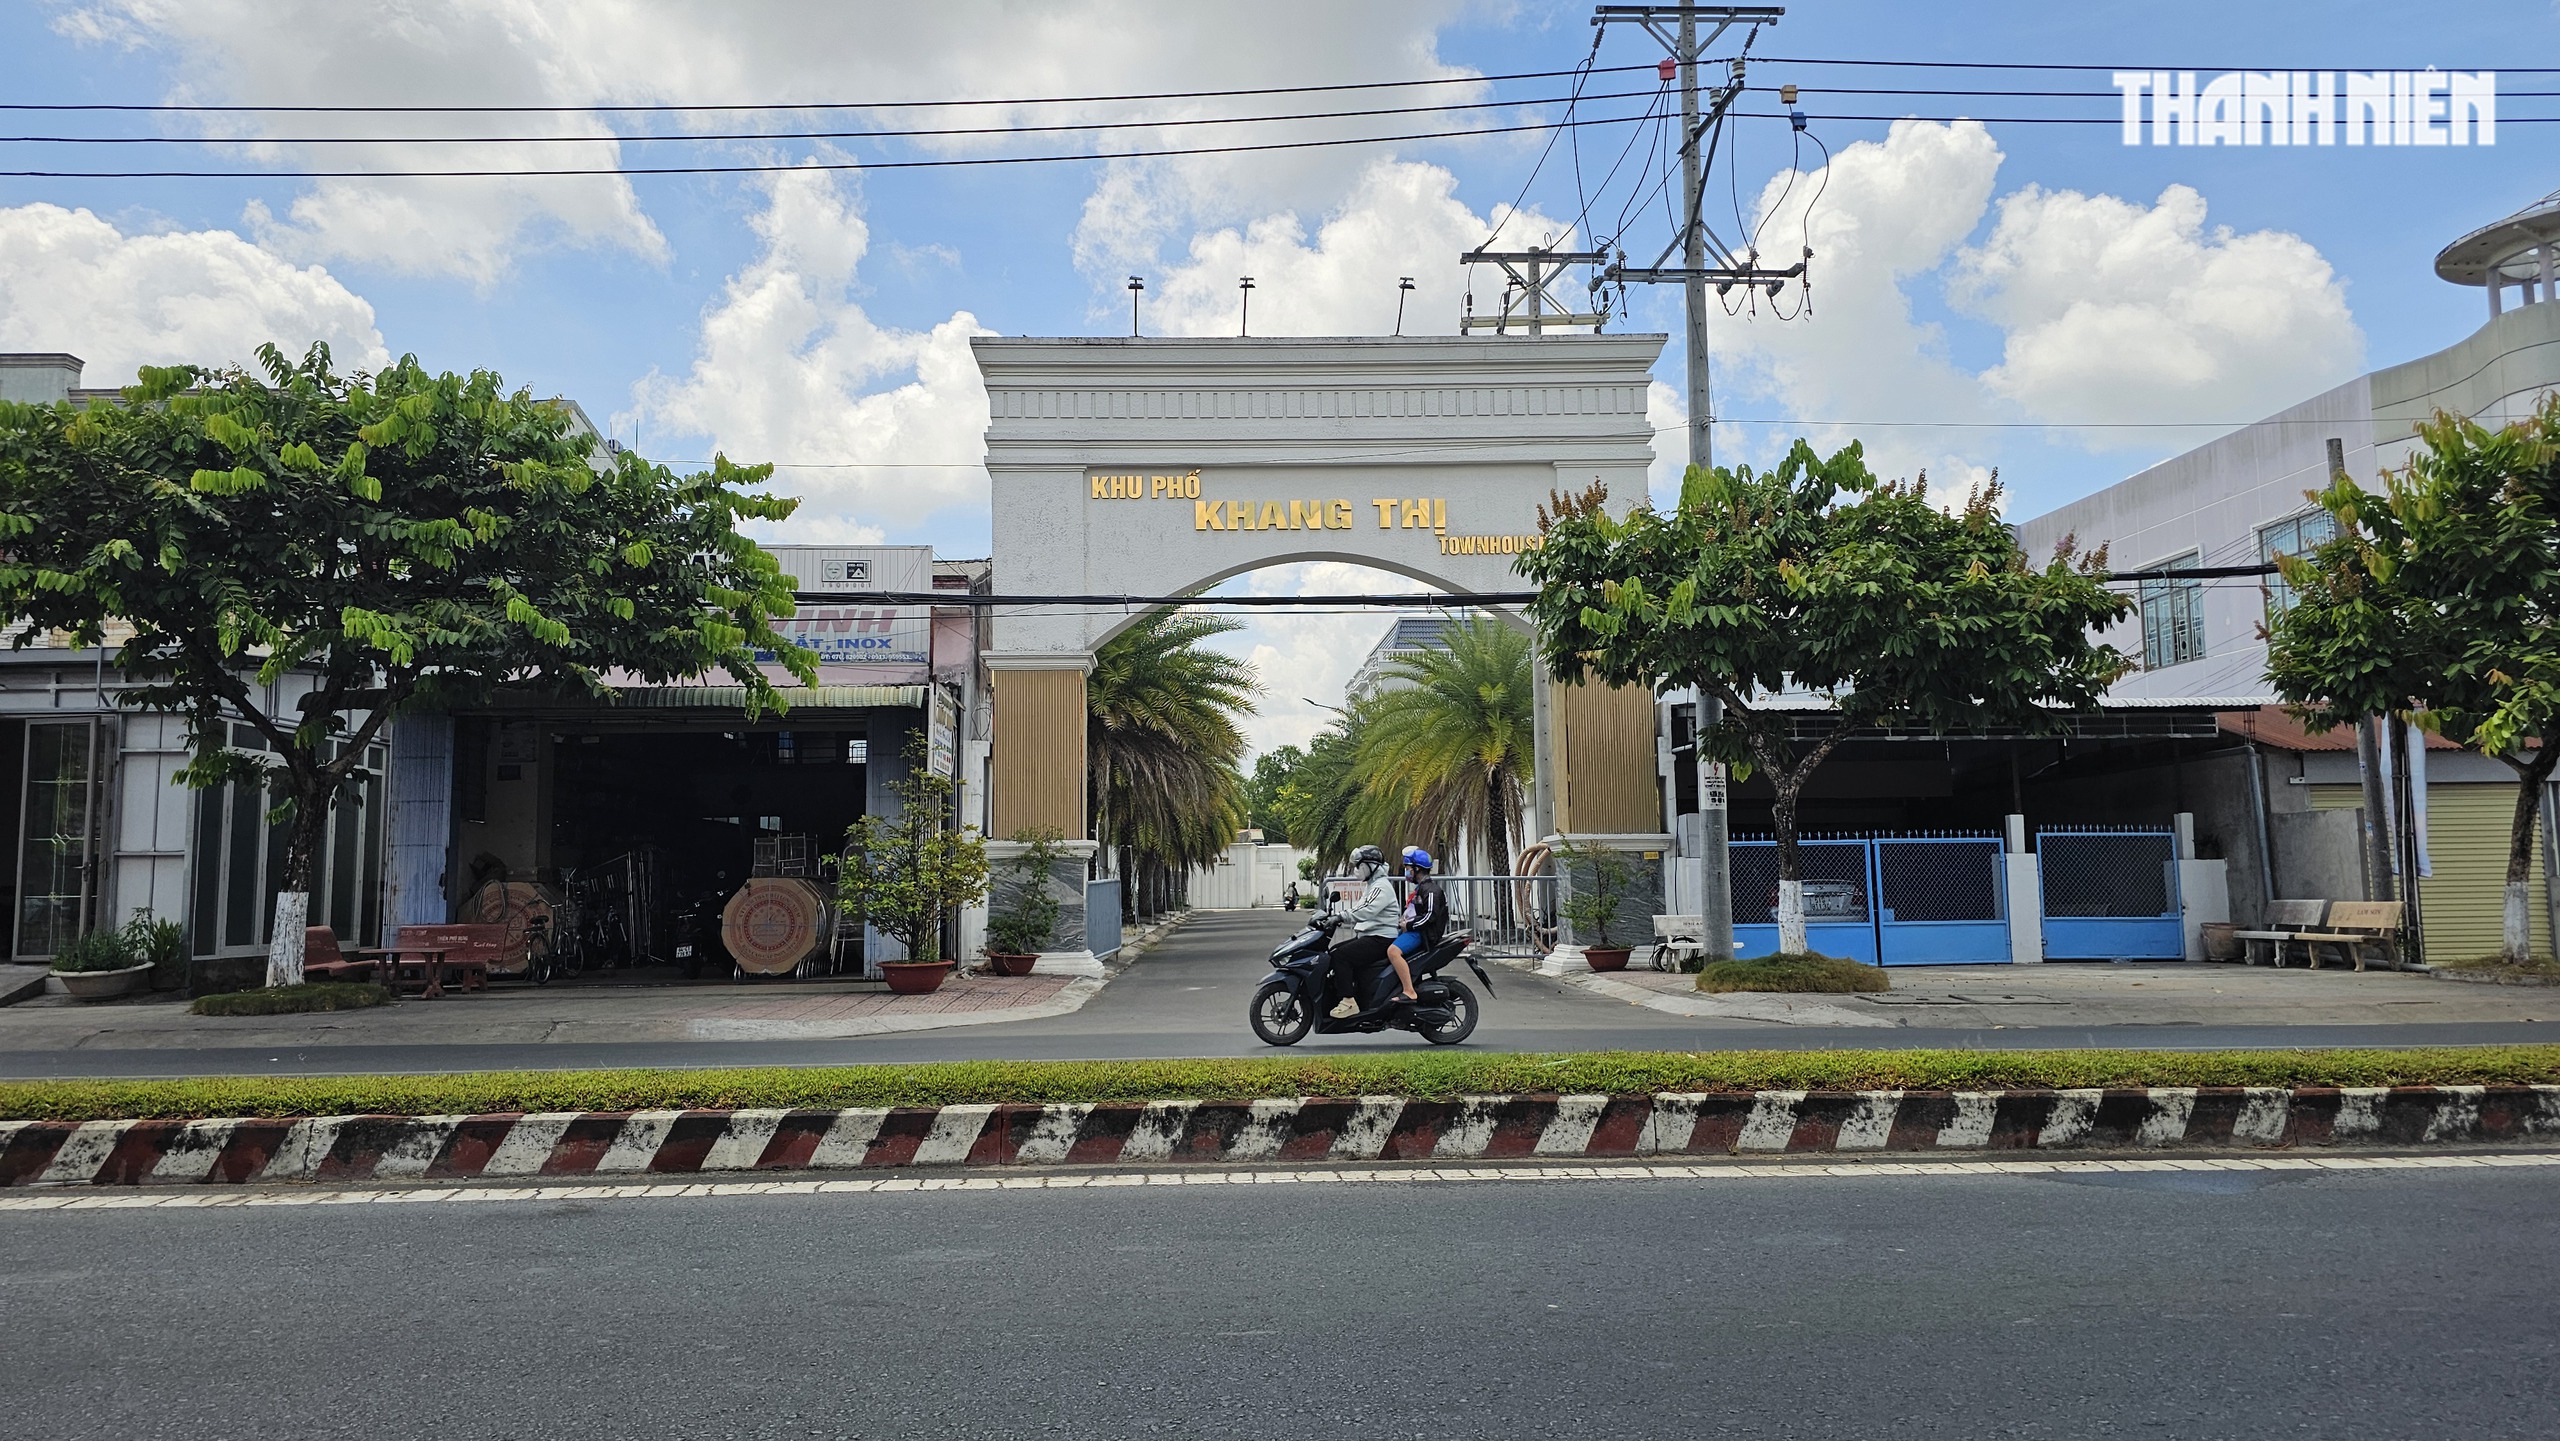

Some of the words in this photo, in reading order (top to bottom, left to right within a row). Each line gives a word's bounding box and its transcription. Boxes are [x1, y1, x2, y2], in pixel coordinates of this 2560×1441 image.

[1091, 475, 1143, 499] KHU
[1151, 468, 1201, 499] PHỐ
[1195, 500, 1353, 531] KHANG
[1372, 498, 1446, 535] THỊ
[837, 638, 892, 649] INOX
